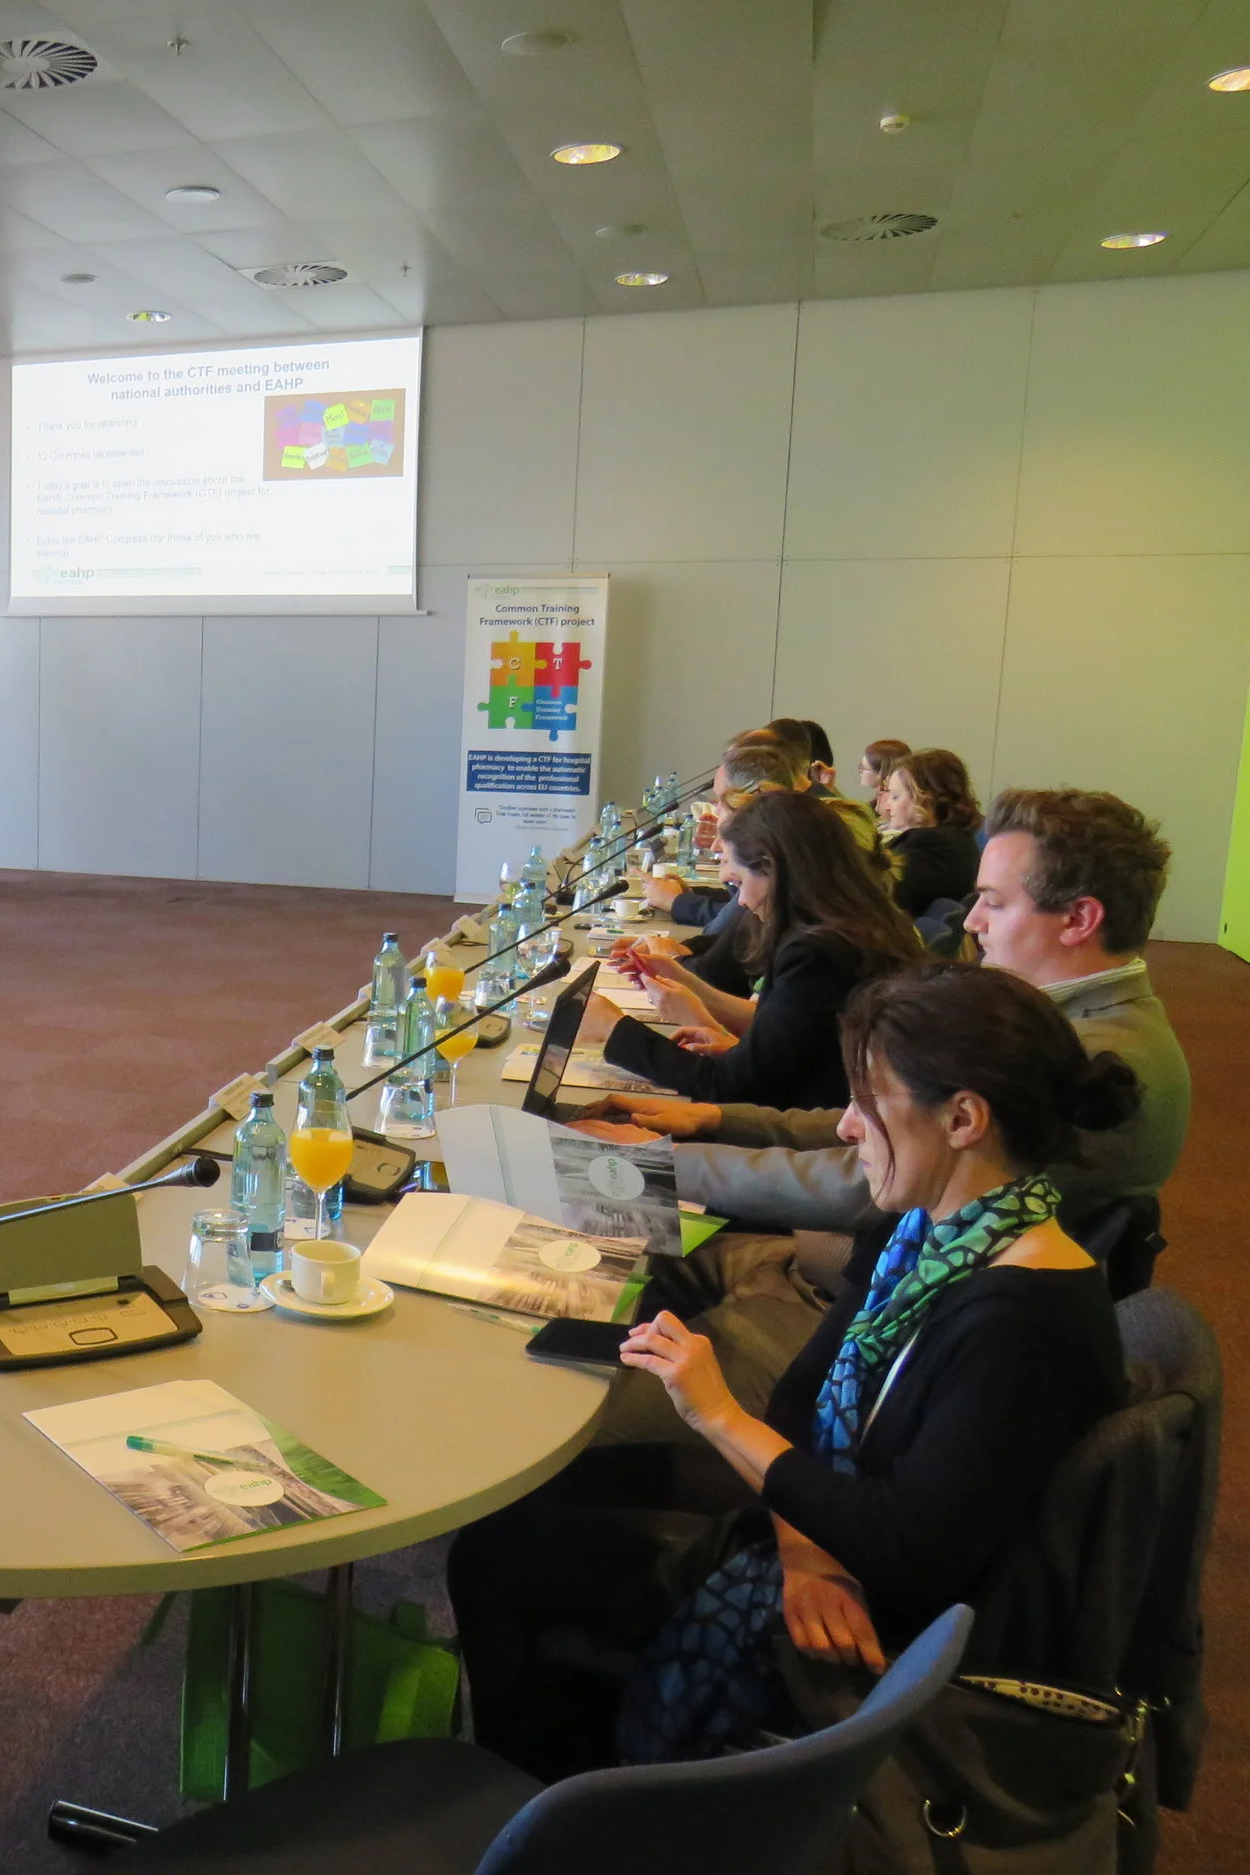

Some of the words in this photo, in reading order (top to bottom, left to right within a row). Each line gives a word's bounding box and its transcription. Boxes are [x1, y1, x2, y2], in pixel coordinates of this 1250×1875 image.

[88, 372, 144, 385] Welcome
[148, 370, 160, 381] to
[164, 368, 184, 380] the
[187, 365, 213, 379] CTF
[218, 363, 270, 377] meeting
[274, 360, 330, 373] between
[111, 387, 161, 401] national
[164, 382, 232, 398] authorities
[236, 380, 261, 393] and
[265, 377, 304, 391] EAHP
[38, 422, 64, 432] Thank
[66, 422, 82, 432] you
[38, 451, 48, 461] 12
[50, 449, 92, 461] Countries
[93, 447, 145, 461] represented
[38, 481, 70, 493] Today's
[72, 480, 91, 492] goal
[112, 479, 135, 491] open
[137, 478, 151, 488] the
[202, 476, 228, 486] about
[230, 475, 246, 485] the
[37, 494, 62, 504] EAHP
[65, 493, 104, 503] Common
[107, 491, 141, 503] Training
[144, 489, 192, 501] Framework
[195, 488, 222, 500] (CTF)
[224, 487, 256, 500] project
[258, 487, 270, 497] for
[36, 536, 60, 547] Enjoy
[78, 535, 104, 544] EAHP
[106, 534, 148, 546] Congress
[205, 533, 222, 544] you
[59, 567, 96, 580] eahp
[494, 585, 520, 596] eahp
[495, 604, 539, 613] Common
[541, 604, 580, 615] Training
[479, 617, 533, 627] Framework
[534, 617, 559, 628] (CTF)
[561, 618, 596, 629] project
[509, 657, 522, 671] C
[553, 658, 564, 670] T
[509, 696, 518, 709] F
[494, 755, 532, 765] developing
[553, 756, 563, 764] for
[563, 756, 591, 766] hospital
[472, 764, 506, 773] pharmacy
[516, 765, 539, 773] enable
[540, 765, 552, 773] the
[552, 766, 587, 774] automatic
[478, 773, 516, 783] recognition
[516, 774, 525, 782] of
[525, 774, 537, 782] the
[539, 775, 580, 784] professional
[475, 782, 515, 792] qualification
[239, 1479, 273, 1490] eahp
